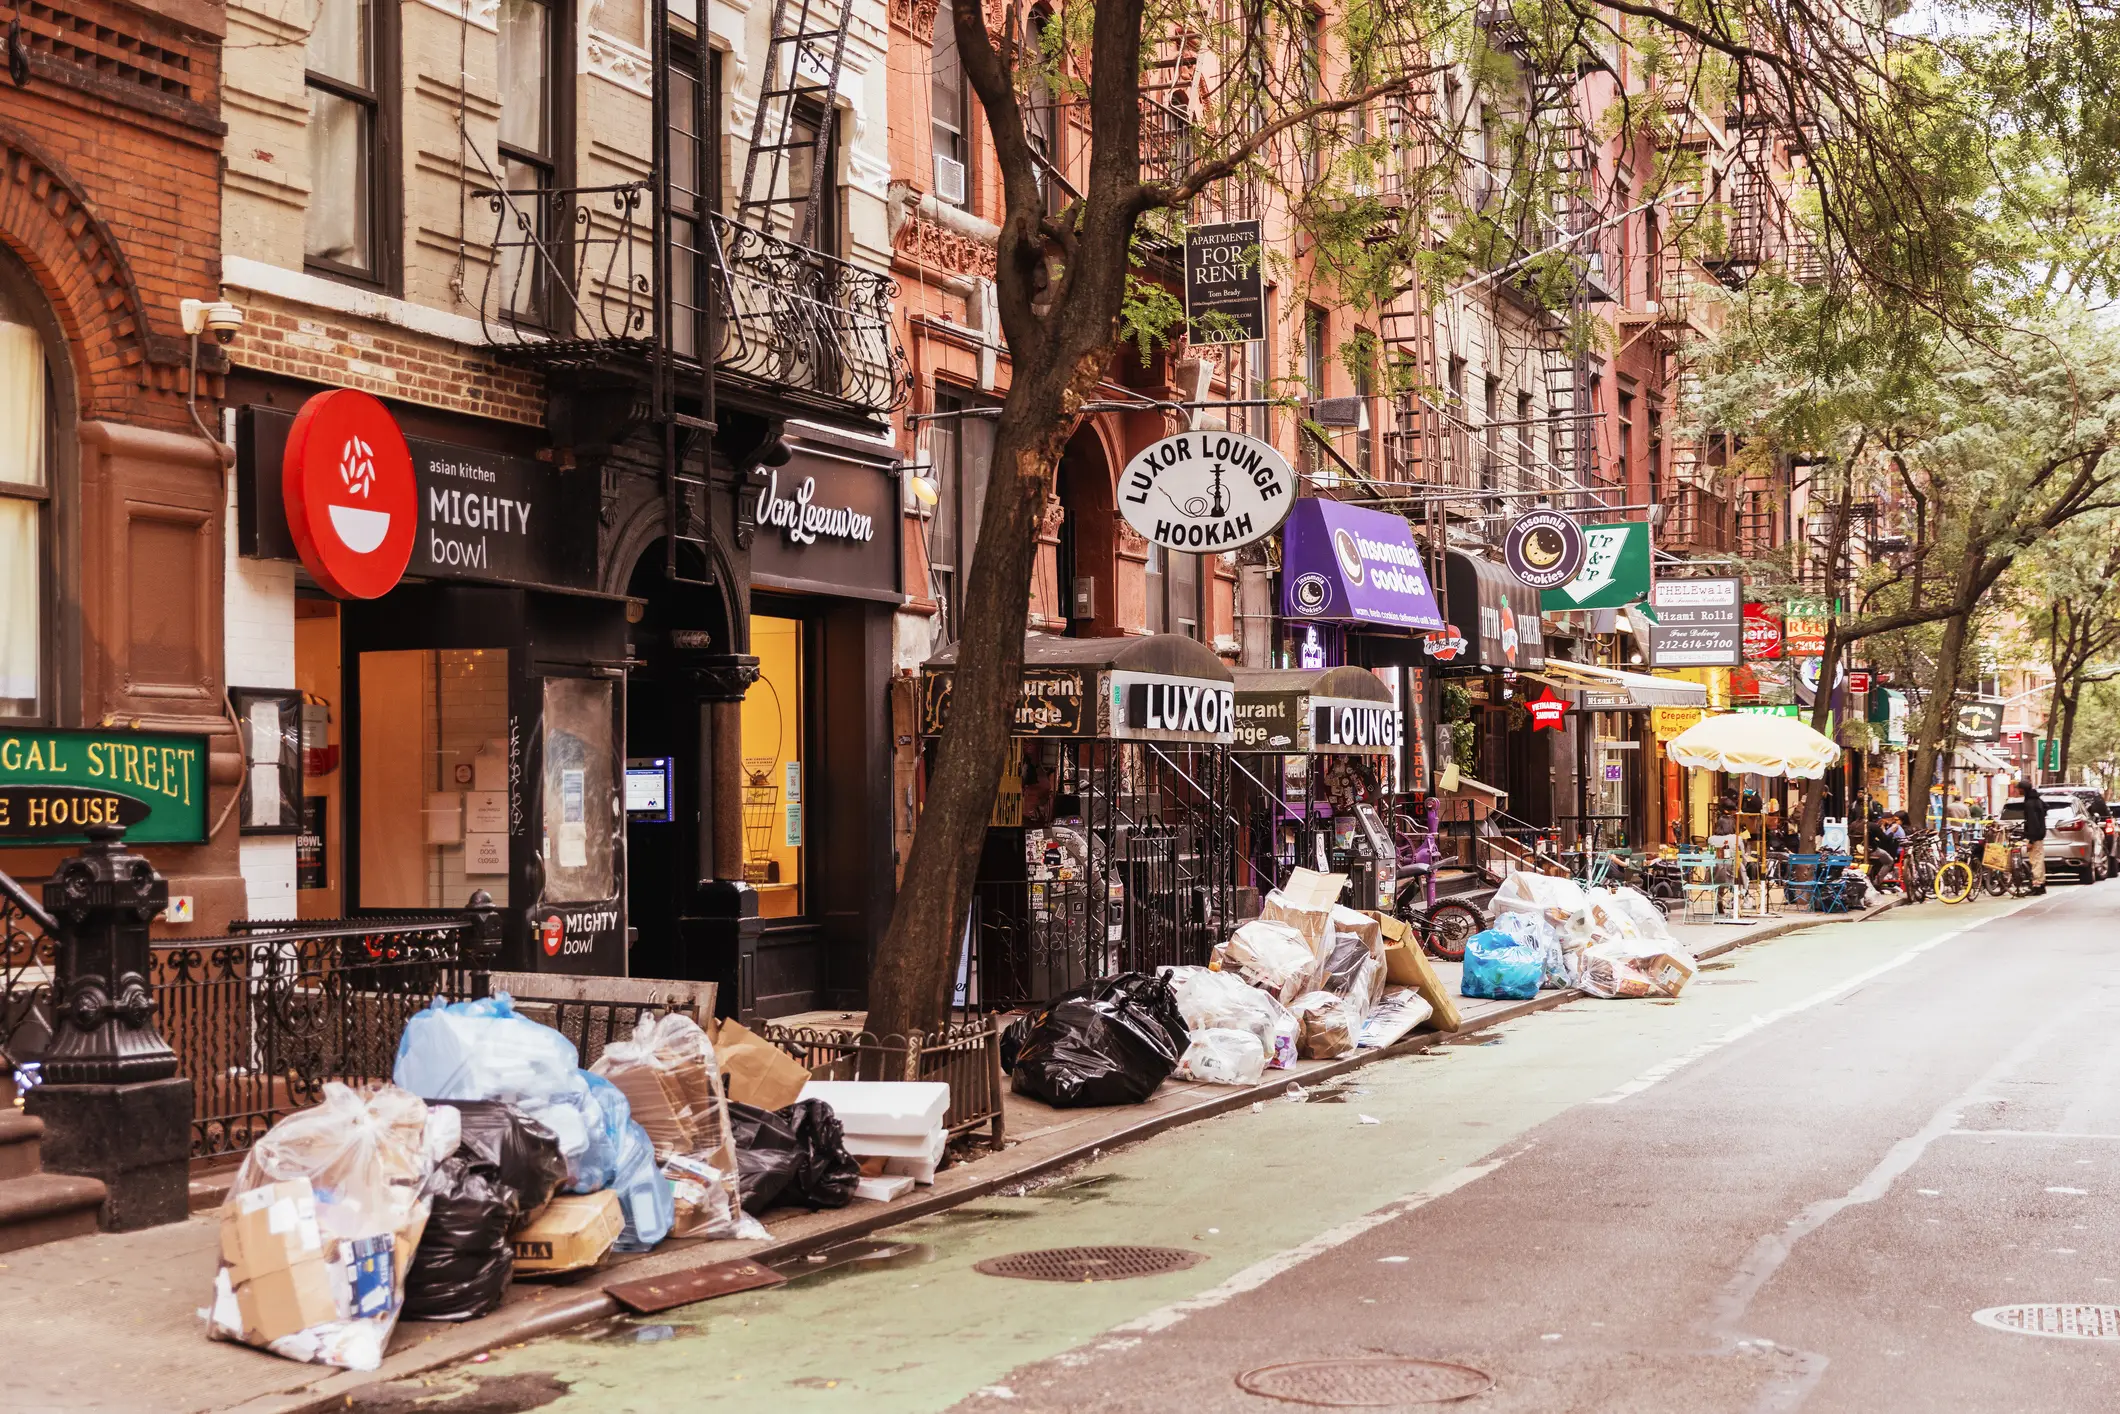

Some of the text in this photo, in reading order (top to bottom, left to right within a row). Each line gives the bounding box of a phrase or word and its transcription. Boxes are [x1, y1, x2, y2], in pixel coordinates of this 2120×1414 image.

[1192, 232, 1254, 246] APARTMENTS
[1202, 246, 1243, 265] FOR
[1195, 264, 1249, 284] RENT
[430, 459, 496, 483] asian kitchen
[1126, 435, 1283, 505] LUXOR LOUNGE
[430, 486, 532, 535] MIGHTY
[754, 467, 874, 545] Van Leeuwen
[1154, 512, 1253, 547] HOOKAH
[1516, 514, 1567, 534] insomnia
[431, 528, 487, 569] bowl
[1354, 530, 1421, 569] insomnia
[1297, 574, 1325, 585] insomnia
[1370, 565, 1426, 597] cookies
[1520, 568, 1565, 586] cookies
[1657, 584, 1732, 596] THELEwala
[1298, 605, 1323, 614] cookies
[1657, 610, 1734, 621] Nizami Rolls
[1657, 640, 1733, 649] 212-614-9100
[1669, 629, 1720, 639] Free Delivery
[1147, 684, 1234, 733] LUXOR
[1661, 711, 1697, 721] Creperie
[1330, 706, 1404, 746] LOUNGE
[1439, 727, 1452, 769] ATM
[2, 738, 195, 806] GAL STREET
[1414, 718, 1424, 815] PIERCING
[28, 798, 120, 826] HOUSE
[297, 835, 323, 847] BOWL
[565, 911, 618, 933] MIGHTY
[563, 935, 595, 956] bowl
